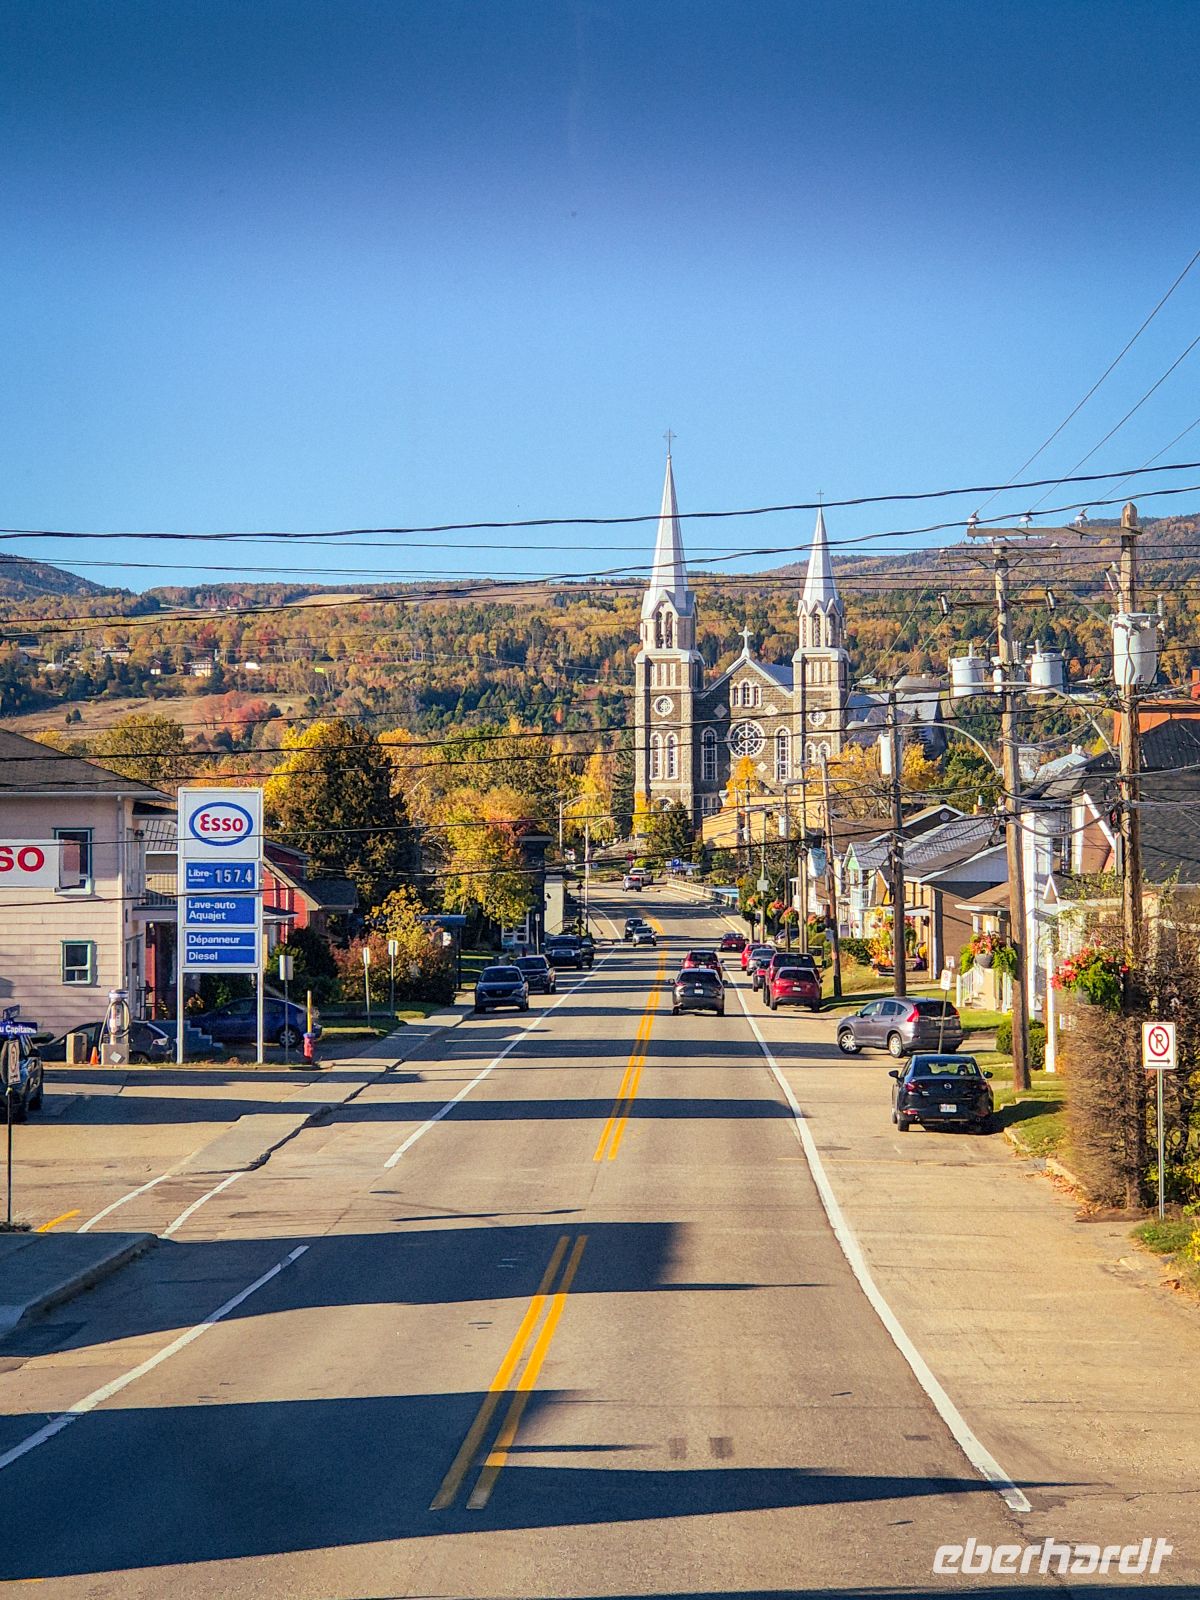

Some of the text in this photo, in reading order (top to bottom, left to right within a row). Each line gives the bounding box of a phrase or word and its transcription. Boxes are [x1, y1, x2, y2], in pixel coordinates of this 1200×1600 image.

[200, 813, 244, 832] Esso
[188, 868, 213, 877] Libre-
[215, 869, 253, 883] 157.4
[188, 899, 236, 909] Lave-auto
[188, 910, 226, 921] Aquajet
[188, 934, 240, 946] Dépanneur
[188, 951, 218, 961] Diesel
